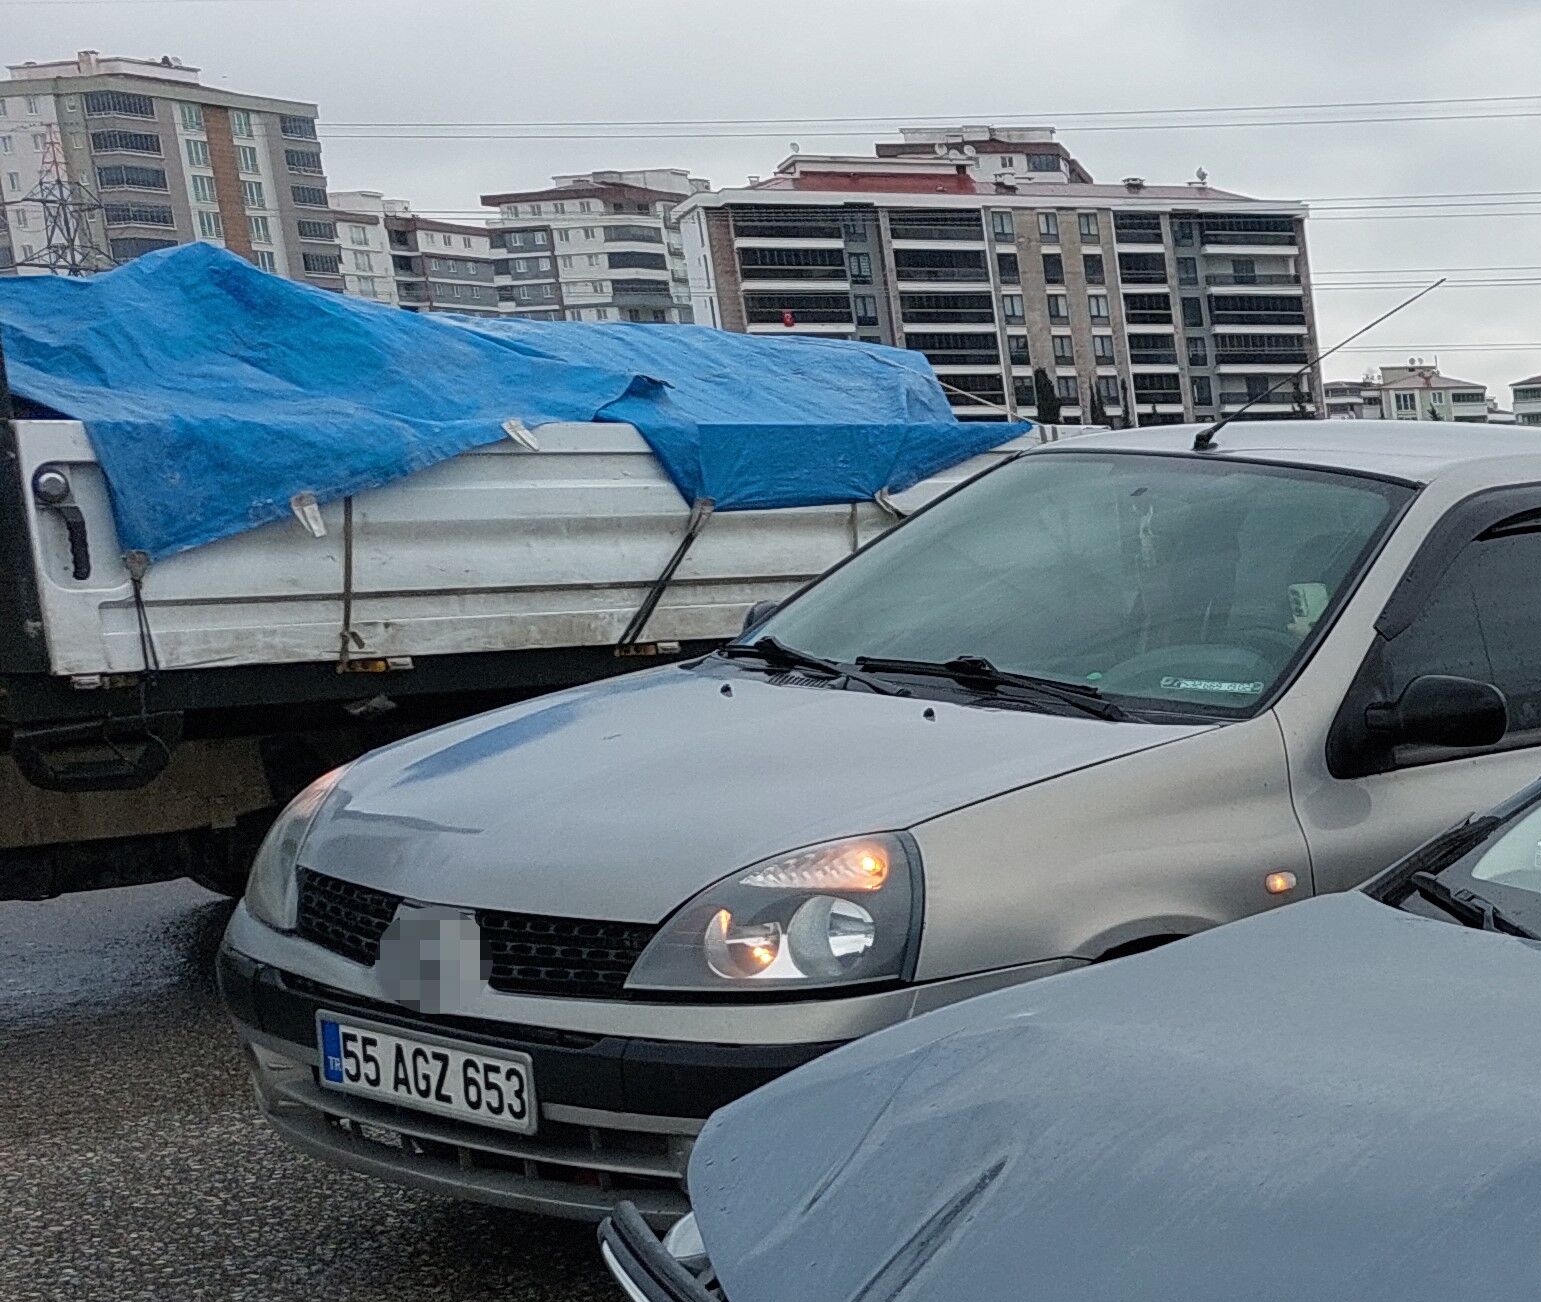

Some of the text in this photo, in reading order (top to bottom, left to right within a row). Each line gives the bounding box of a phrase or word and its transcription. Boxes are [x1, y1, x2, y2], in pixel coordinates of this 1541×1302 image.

[342, 1031, 527, 1120] 55 AGZ 653
